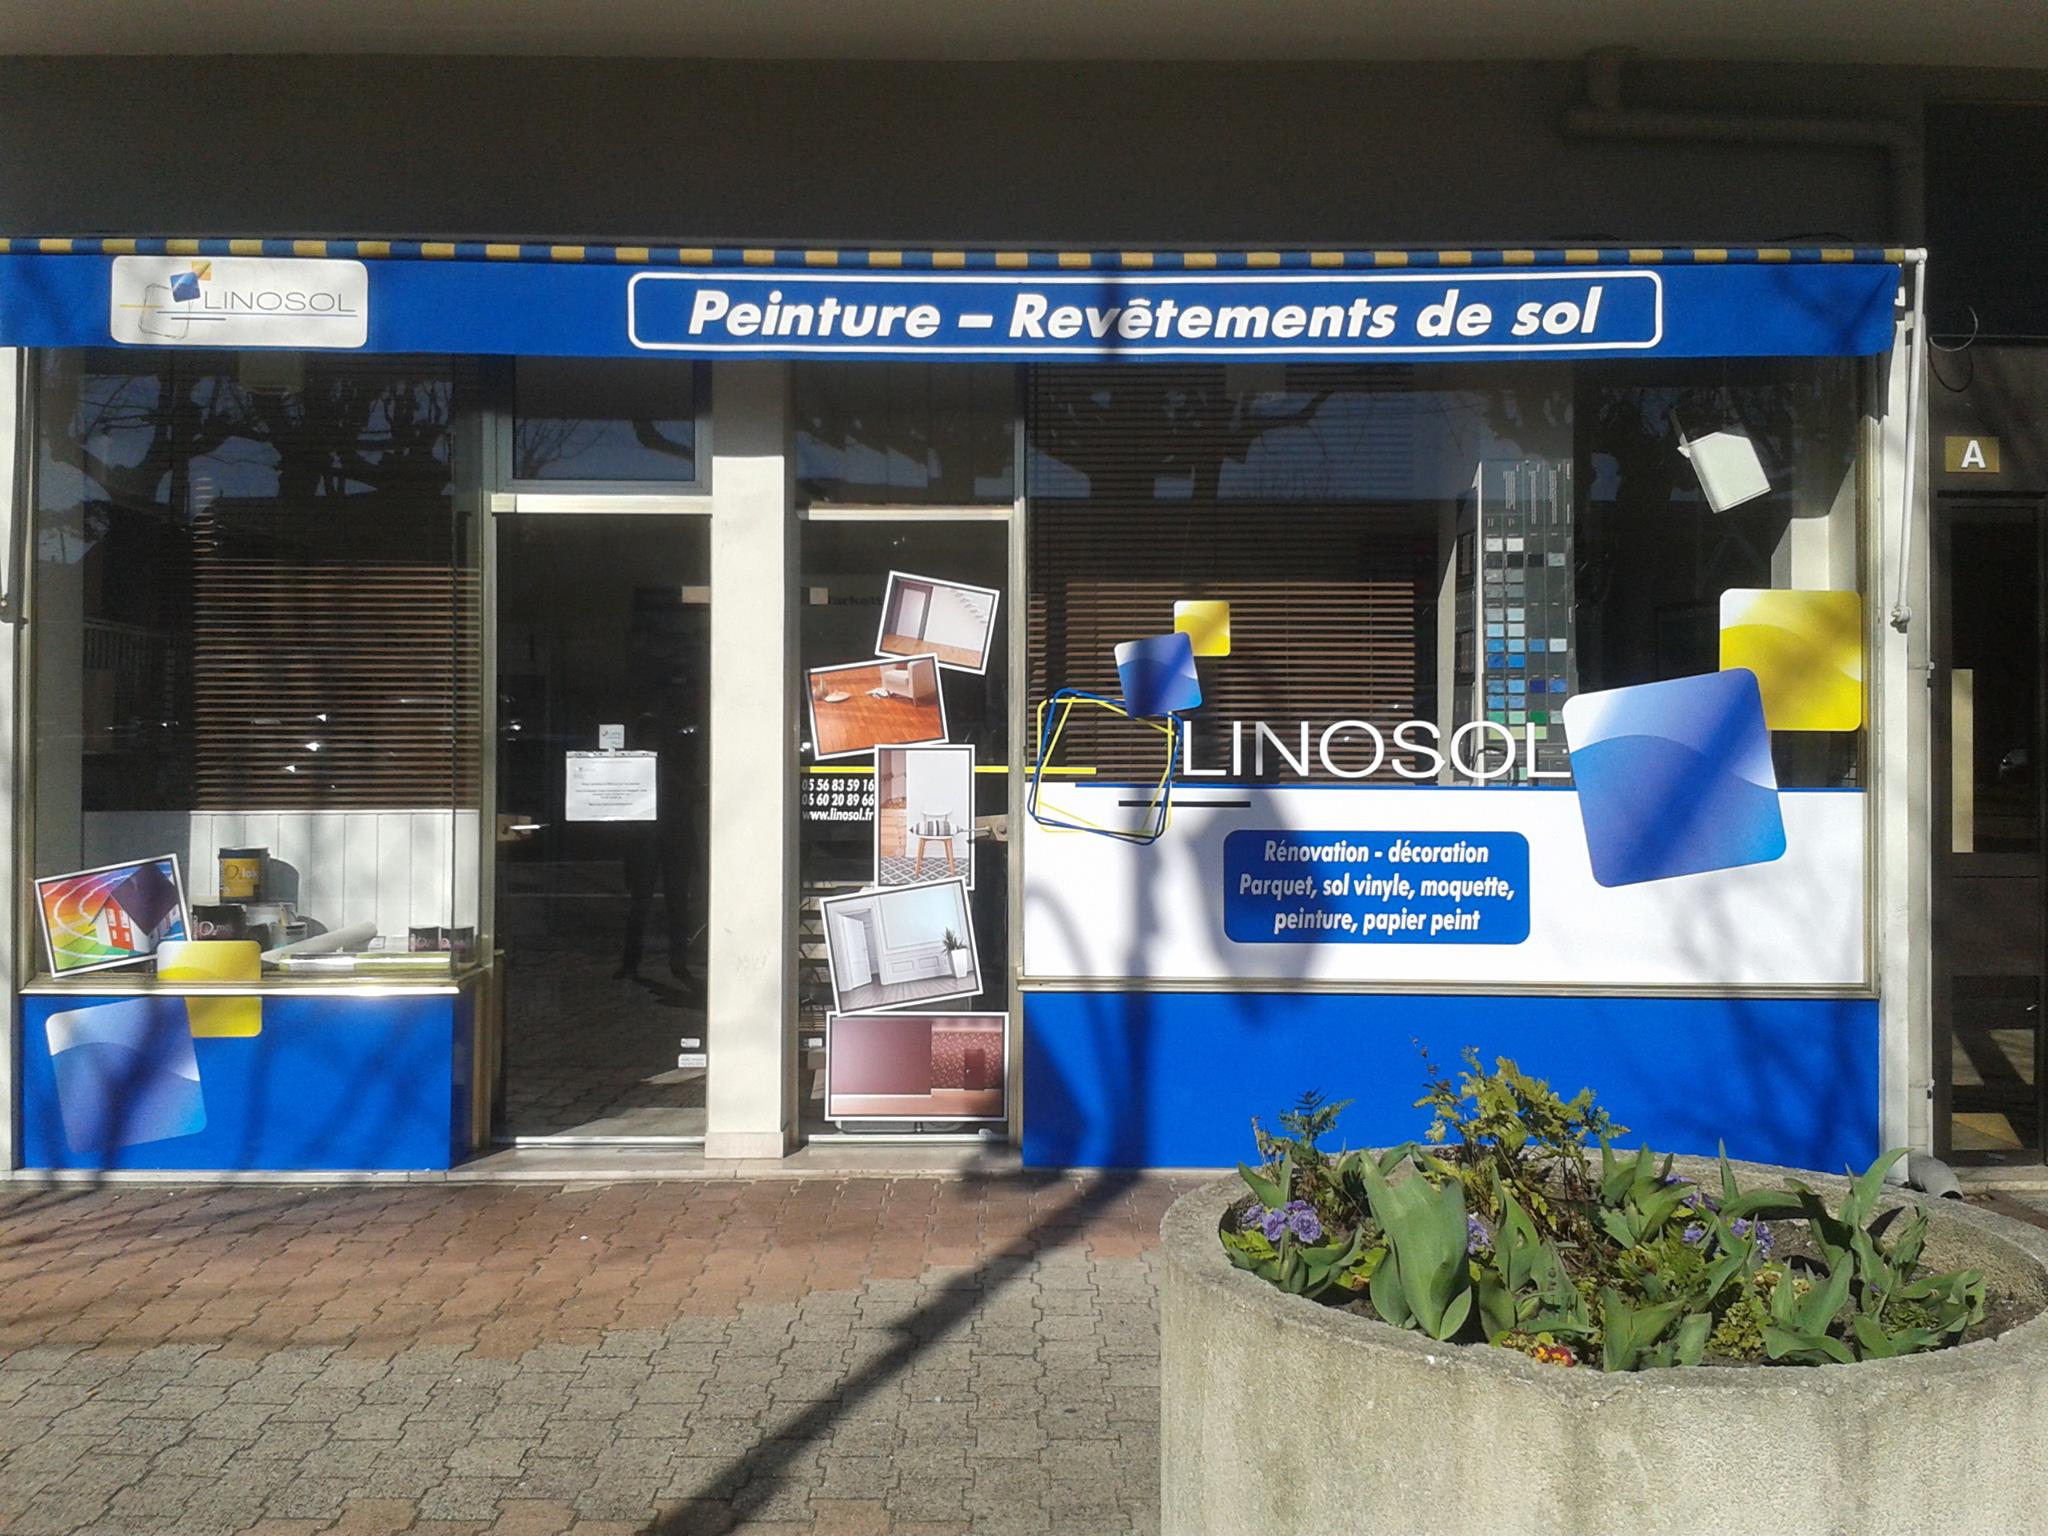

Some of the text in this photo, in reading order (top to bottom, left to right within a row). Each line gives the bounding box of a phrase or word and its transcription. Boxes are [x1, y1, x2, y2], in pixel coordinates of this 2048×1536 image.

[204, 290, 357, 312] LINOSOL
[687, 289, 941, 339] Peinture
[1008, 292, 1398, 339] Revêtements
[1416, 287, 1493, 338] de
[1510, 285, 1603, 336] sol
[1961, 439, 1986, 468] A
[1182, 720, 1572, 779] LINOSOL
[801, 778, 875, 792] 05 56 83 59 16
[801, 793, 875, 806] 05 60 20 89 66
[802, 807, 874, 821] www.linosol.fr
[1264, 840, 1369, 863] Rénovation
[1388, 839, 1489, 863] décoration
[1239, 873, 1515, 902] Parquet, sol vinyle, moquette,
[1274, 907, 1481, 936] peinture, papier peint
